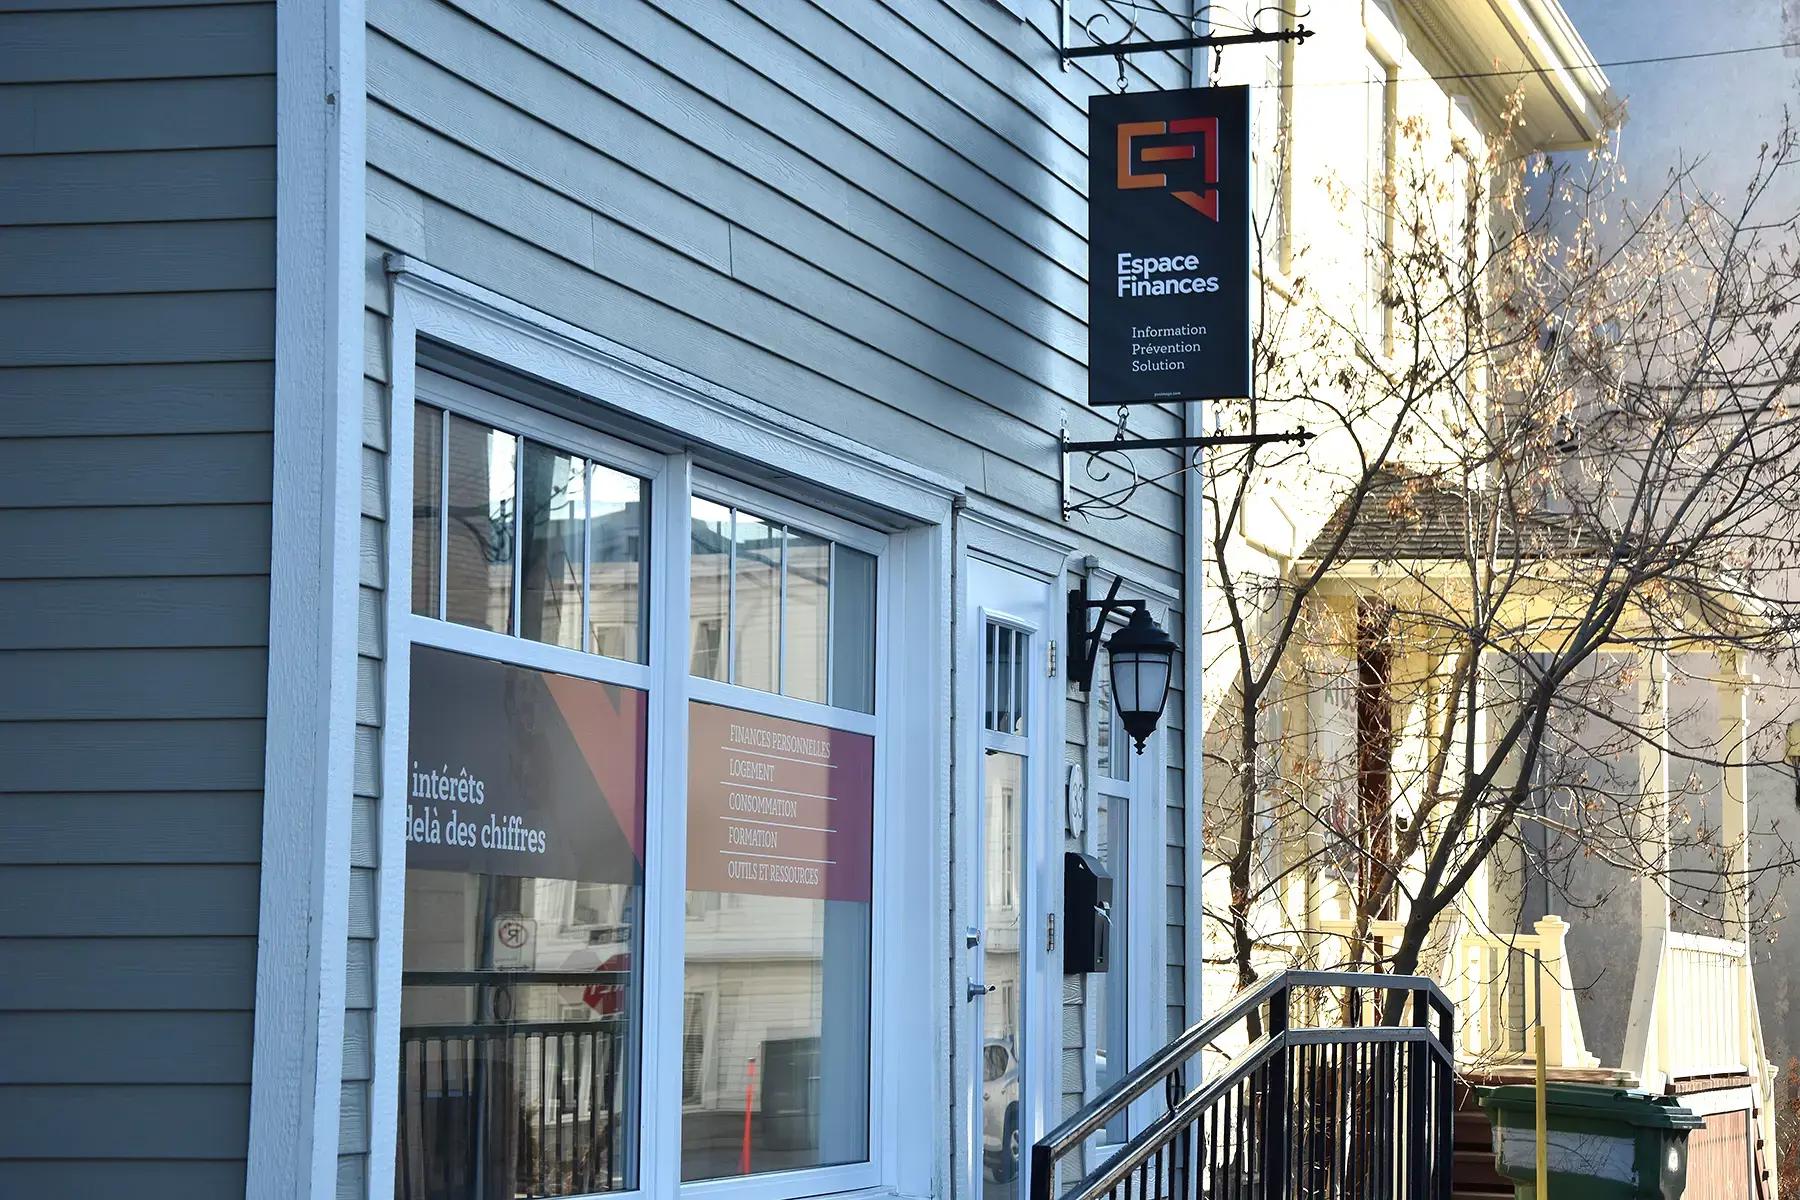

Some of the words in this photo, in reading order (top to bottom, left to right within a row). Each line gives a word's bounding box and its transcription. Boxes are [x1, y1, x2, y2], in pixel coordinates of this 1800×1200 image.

[1117, 253, 1199, 279] Espace
[1117, 275, 1219, 297] Finances
[1131, 325, 1207, 338] Information
[1131, 342, 1201, 355] Prévention
[1131, 359, 1185, 372] Solution
[730, 724, 771, 749] FINANCES
[772, 732, 831, 759] PERSONNELLES
[729, 758, 775, 782] LOGEMENT
[412, 761, 485, 805] intérêts
[728, 792, 797, 818] CONSOMMATION
[446, 810, 477, 848] des
[480, 814, 546, 854] chiffres
[728, 826, 778, 848] FORMATION
[728, 860, 758, 880] OUTILS
[759, 864, 770, 880] ET
[770, 865, 819, 885] RESSOURCES
